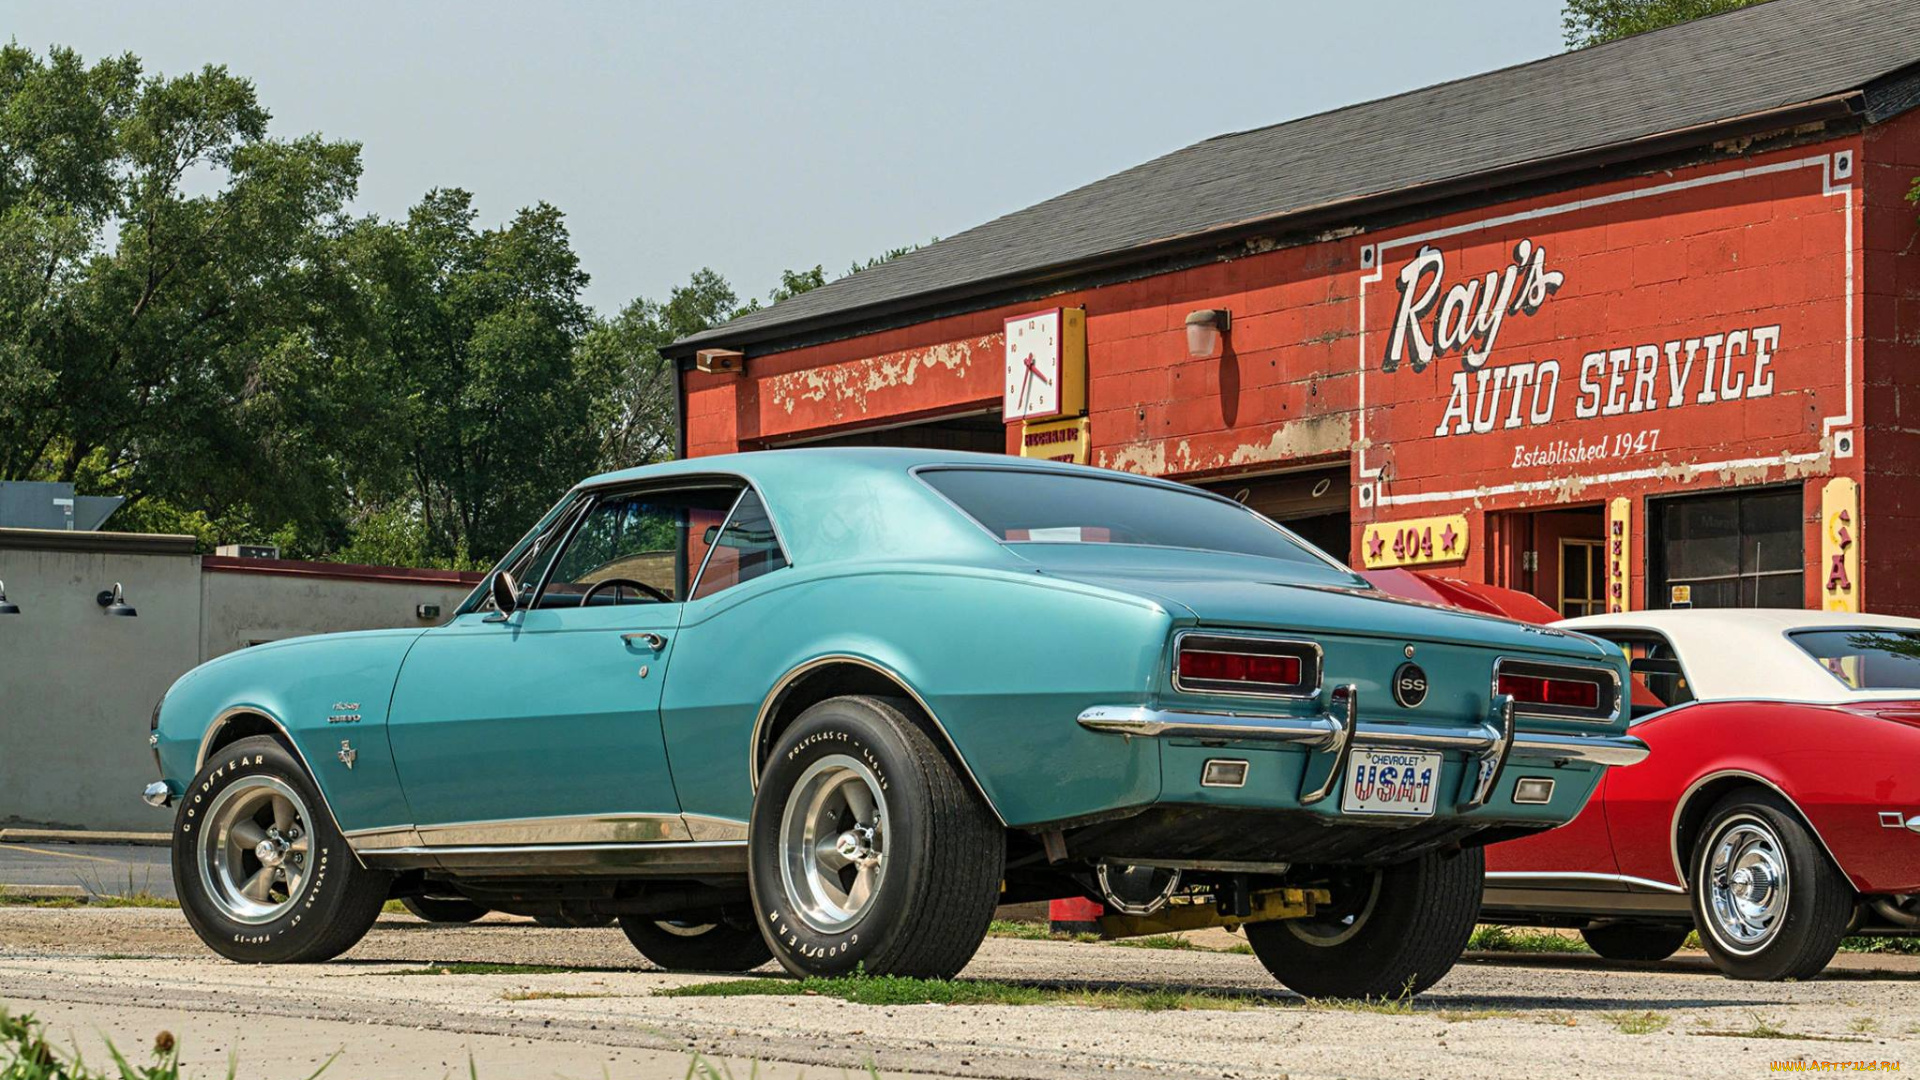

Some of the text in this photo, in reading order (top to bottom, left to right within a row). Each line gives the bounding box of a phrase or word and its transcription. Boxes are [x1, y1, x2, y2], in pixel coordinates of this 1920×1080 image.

[1384, 238, 1565, 371] Ray's
[1435, 323, 1781, 437] AUTO SERVICE
[1512, 429, 1661, 469] Established 1947
[1392, 526, 1433, 559] 404
[1401, 678, 1425, 691] SS
[1371, 754, 1420, 767] CHEVROLET
[183, 754, 264, 832] GOODYEAR
[769, 909, 860, 959] GOODYEAR
